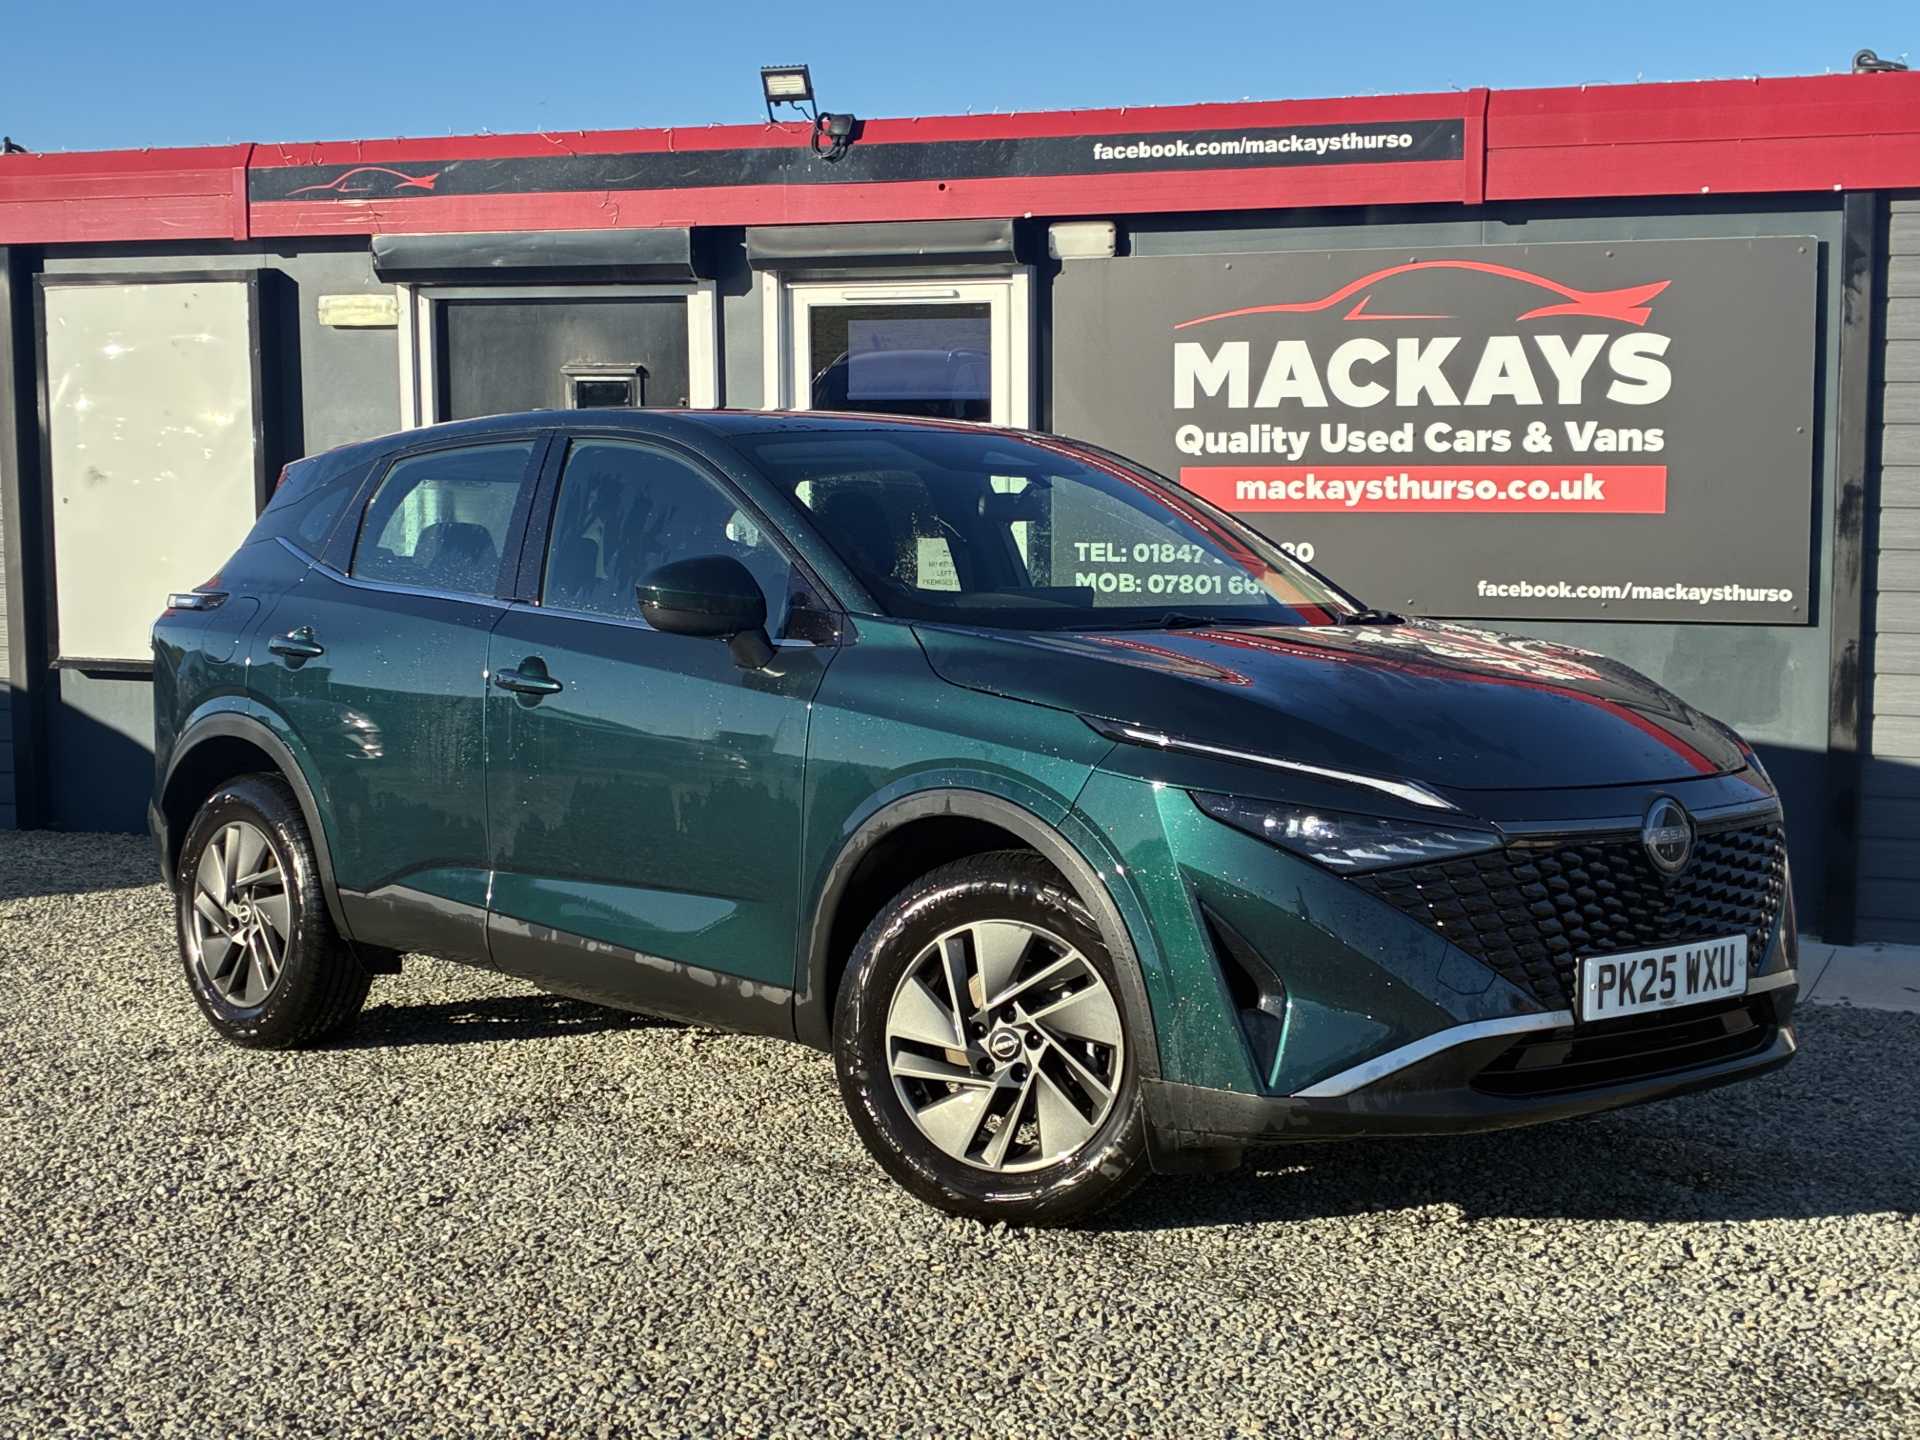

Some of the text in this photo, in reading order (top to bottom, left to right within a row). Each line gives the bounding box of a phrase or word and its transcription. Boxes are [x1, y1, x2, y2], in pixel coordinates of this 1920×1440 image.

[1092, 131, 1414, 161] facebook.com/mackaysthurso
[1173, 332, 1673, 410] MACKAYS
[1174, 420, 1666, 461] Quality Used Cars & Vans
[1234, 472, 1606, 507] mackaysthurso.co.uk
[1074, 541, 1206, 564] TEL: 01847
[1075, 573, 1142, 594] MOB:
[1146, 574, 1223, 595] 07801
[1476, 578, 1794, 604] facebook.com/mackaysthurso
[1597, 944, 1736, 1010] PK25 WXU
